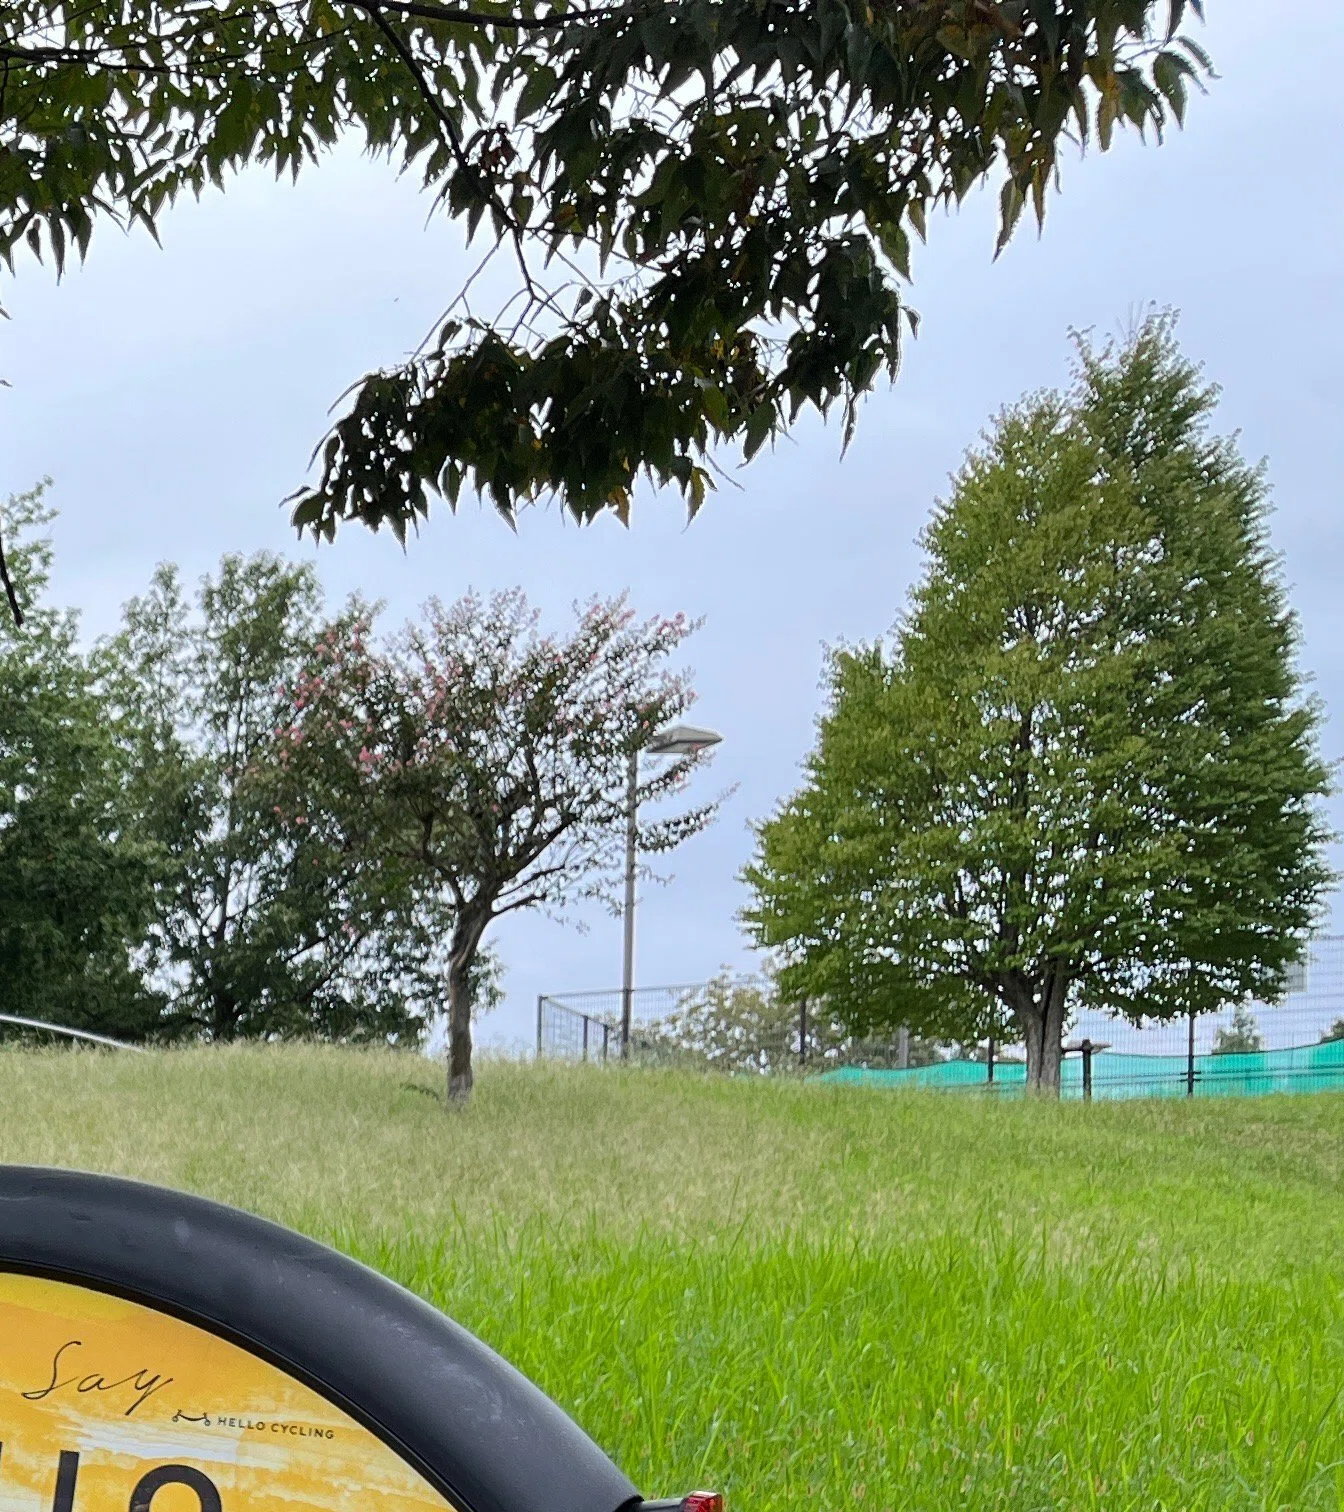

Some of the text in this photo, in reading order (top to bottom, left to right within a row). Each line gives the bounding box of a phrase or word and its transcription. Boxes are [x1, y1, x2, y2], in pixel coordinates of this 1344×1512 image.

[20, 1340, 174, 1416] Say
[217, 1417, 335, 1440] HELLO CYCLING
